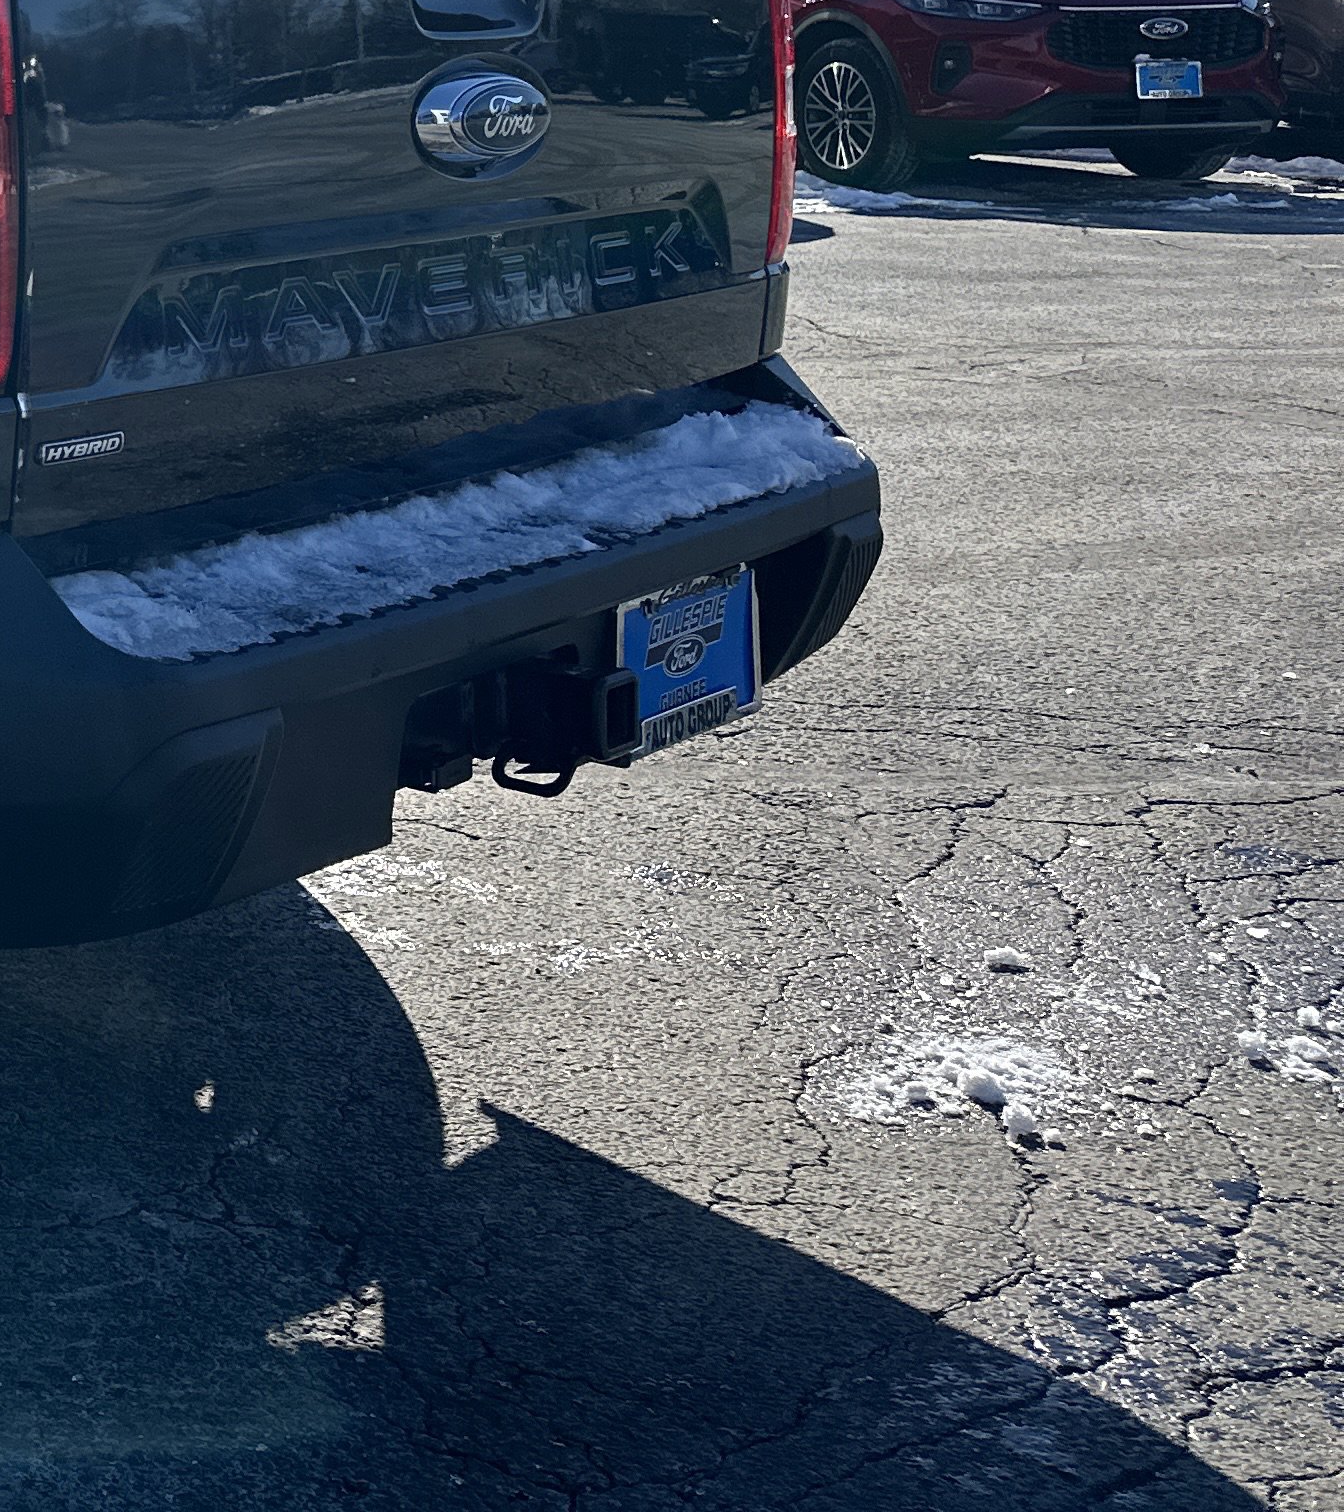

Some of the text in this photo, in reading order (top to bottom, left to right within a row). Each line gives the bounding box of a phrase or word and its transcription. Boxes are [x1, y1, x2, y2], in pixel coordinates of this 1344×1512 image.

[484, 95, 536, 139] Ford
[158, 221, 690, 356] MAVERICK
[45, 437, 120, 462] HYBRID
[650, 594, 727, 642] GILLESPIE
[670, 643, 698, 671] Ford
[688, 693, 731, 734] GROUP
